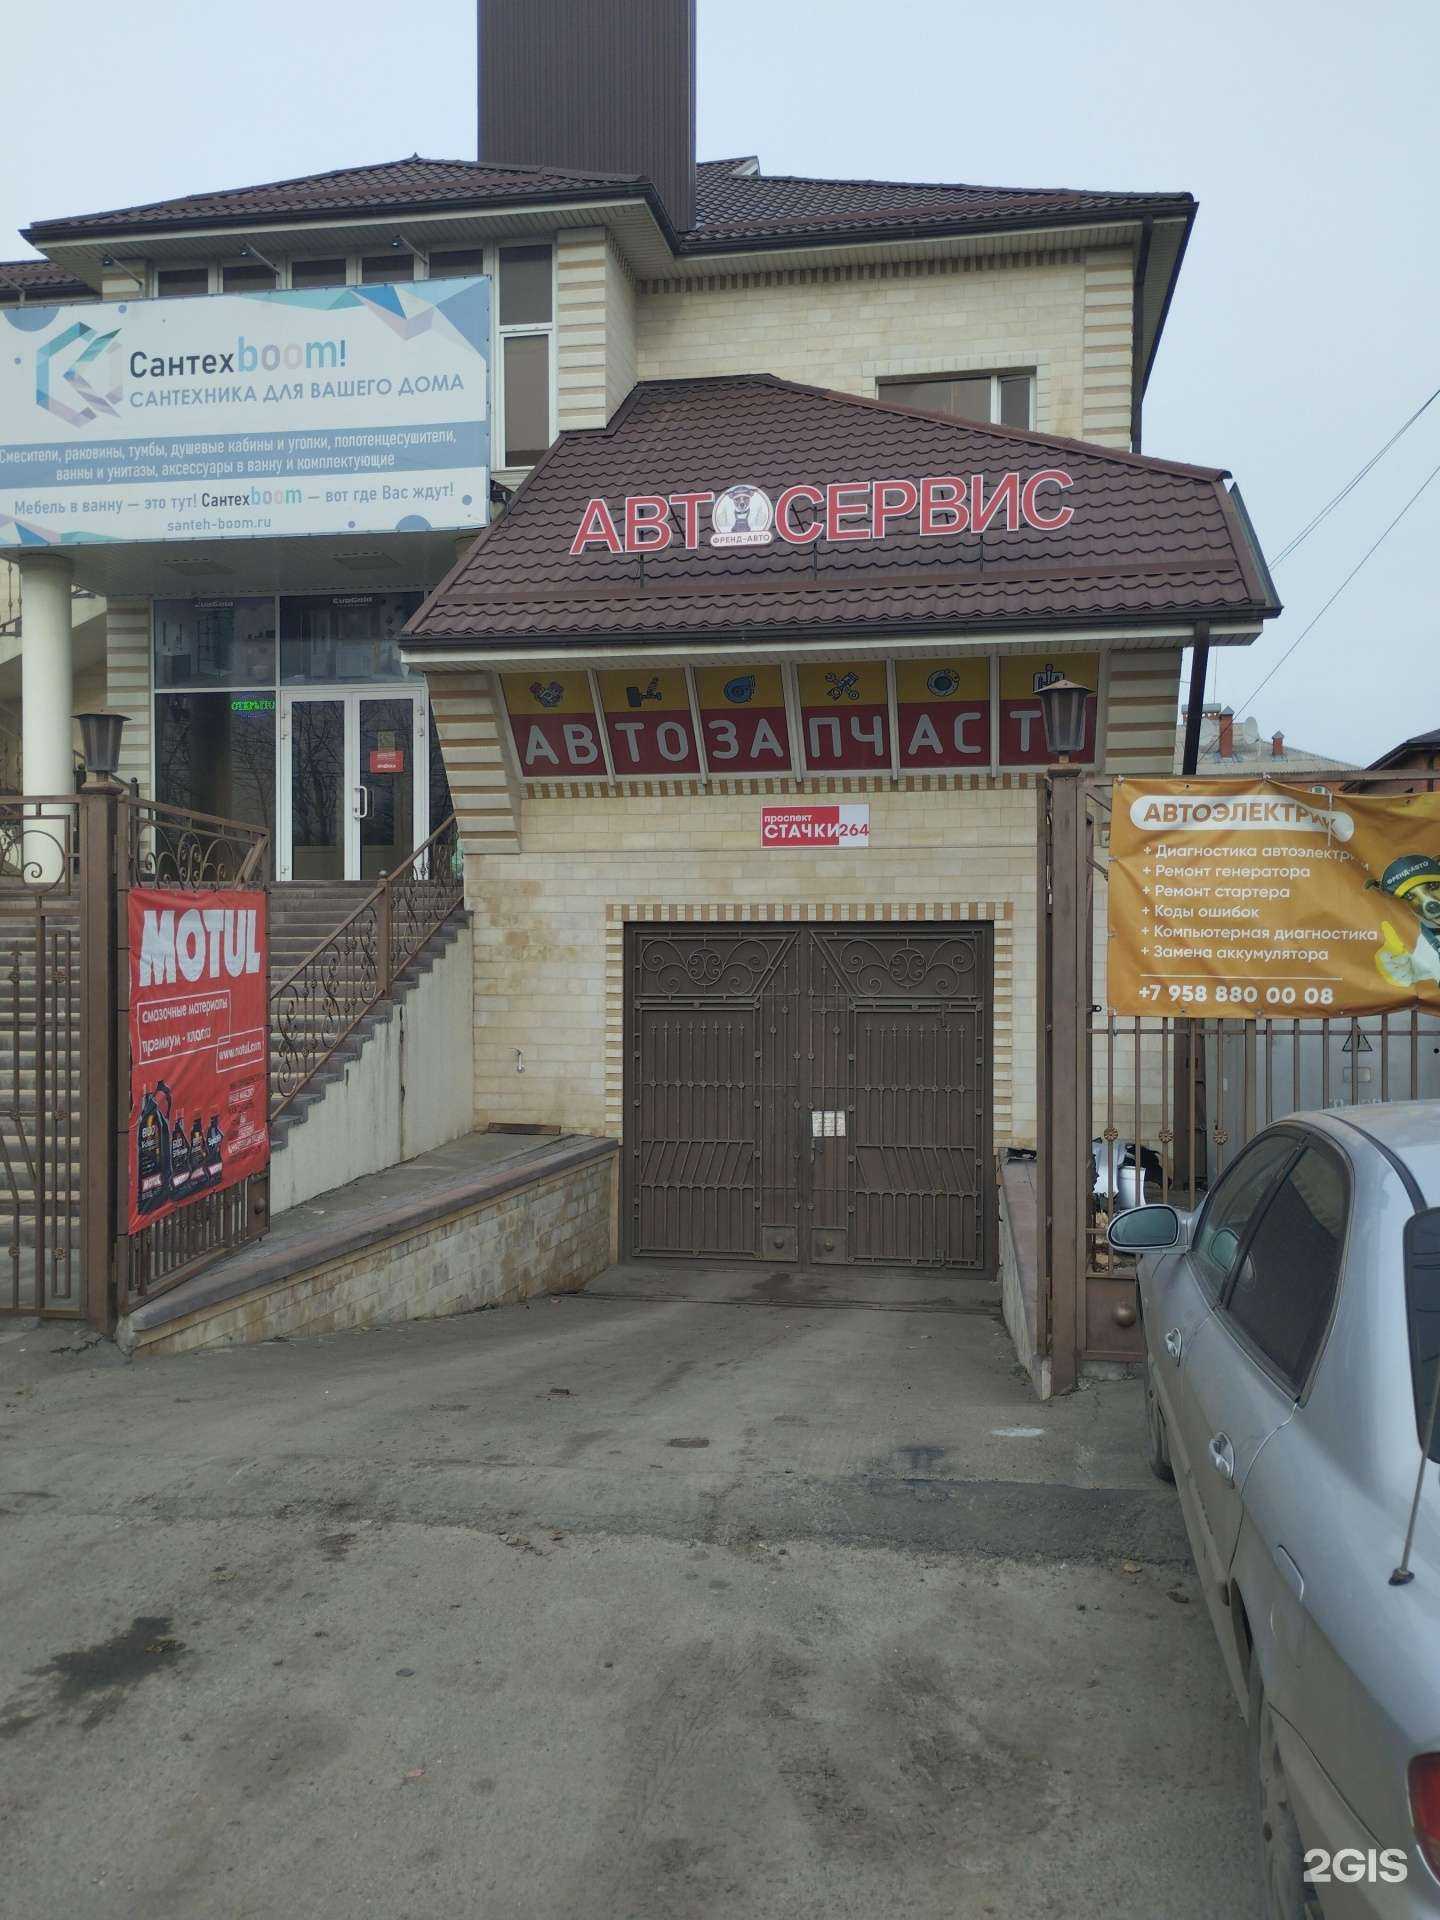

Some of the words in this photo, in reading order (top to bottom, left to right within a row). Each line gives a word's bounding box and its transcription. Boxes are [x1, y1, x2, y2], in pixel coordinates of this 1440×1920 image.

[130, 335, 346, 378] Сантехboom!
[129, 385, 257, 408] САНТЕХНИКА
[263, 383, 303, 403] ДЛЯ
[311, 378, 392, 399] ВАШЕГО
[398, 373, 464, 396] ДОМА
[65, 445, 125, 464] раковины,
[129, 441, 168, 461] тумбы,
[171, 439, 225, 457] душевые
[228, 436, 273, 453] кабины
[277, 439, 285, 450] и
[289, 435, 331, 454] уголки,
[335, 429, 457, 449] полотенцесушители,
[56, 466, 93, 481] ванны
[97, 466, 104, 479] и
[107, 463, 158, 482] унитазы,
[162, 460, 233, 477] аксессуары
[237, 461, 243, 473] в
[247, 458, 282, 475] ванну
[286, 457, 294, 469] и
[297, 452, 395, 470] комплектующие
[15, 499, 66, 515] Мебель
[70, 500, 77, 513] в
[82, 498, 123, 514] ванну
[144, 497, 166, 509] это
[172, 493, 198, 509] тут!
[201, 486, 302, 508] Сантехboom
[326, 489, 349, 502] вот
[354, 488, 376, 503] где
[382, 484, 408, 500] Вас
[412, 481, 454, 502] ждут!
[167, 518, 271, 532] santeh-boom.ru
[524, 710, 1044, 766] АВТОЗАПЧАСТ
[764, 814, 812, 825] проспект
[764, 823, 839, 839] СТАЧКИ
[839, 823, 870, 837] 264
[1156, 845, 1257, 859] Диагностика
[1155, 864, 1211, 877] Ремонт
[1215, 865, 1311, 880] генератора
[1155, 885, 1210, 897] Ремонт
[1215, 886, 1290, 900] стартера
[1154, 905, 1193, 919] Коды
[1198, 905, 1260, 918] ошибок
[1154, 925, 1270, 941] Компьютерная
[1274, 928, 1378, 941] диагностика
[139, 908, 261, 987] MOTUL
[1153, 945, 1212, 958] Замена
[1216, 947, 1329, 962] аккумулятора
[1139, 985, 1161, 1001] +7
[1168, 985, 1207, 1002] 958
[1215, 986, 1258, 1003] 880
[1266, 987, 1296, 1004] 00
[1304, 987, 1334, 1005] 08
